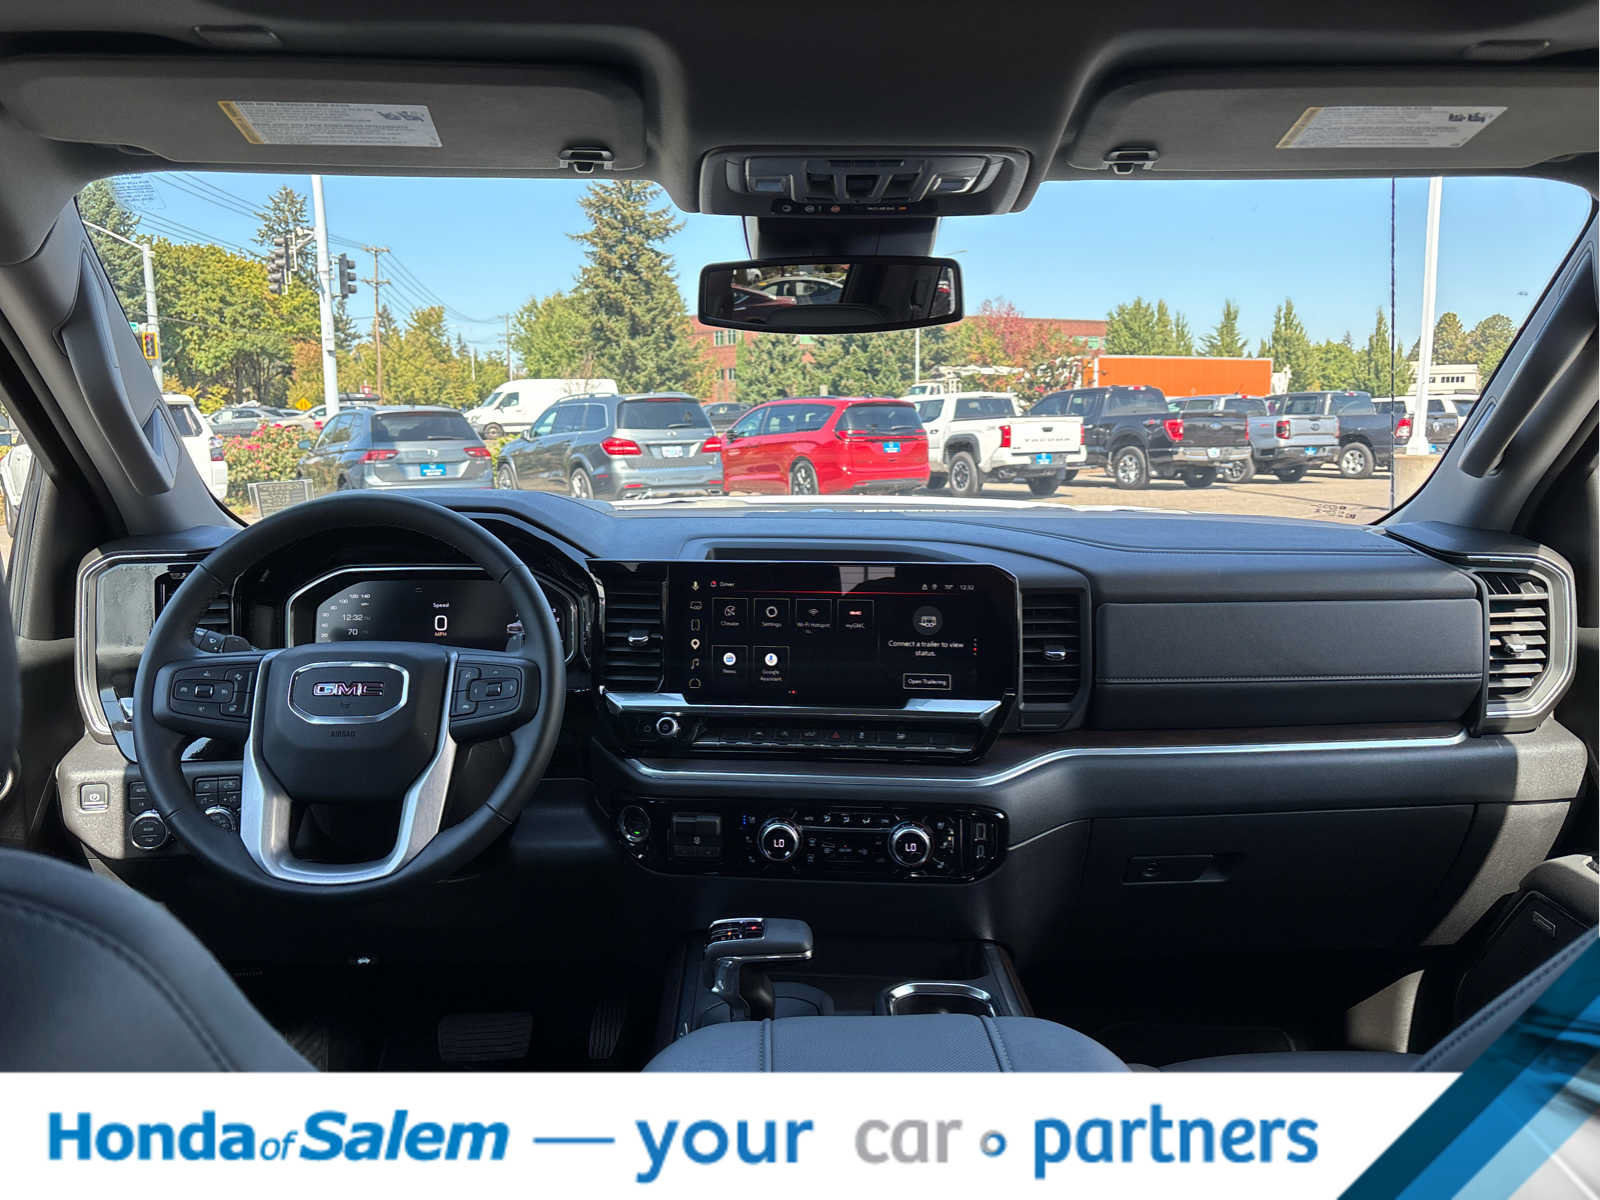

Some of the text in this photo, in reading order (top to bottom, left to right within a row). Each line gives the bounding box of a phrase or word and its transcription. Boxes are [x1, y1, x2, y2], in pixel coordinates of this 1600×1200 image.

[434, 615, 448, 632] 0
[347, 628, 359, 636] 70
[888, 640, 916, 648] Connect
[313, 682, 384, 696] GMC
[773, 839, 785, 848] LO
[905, 843, 917, 852] LO
